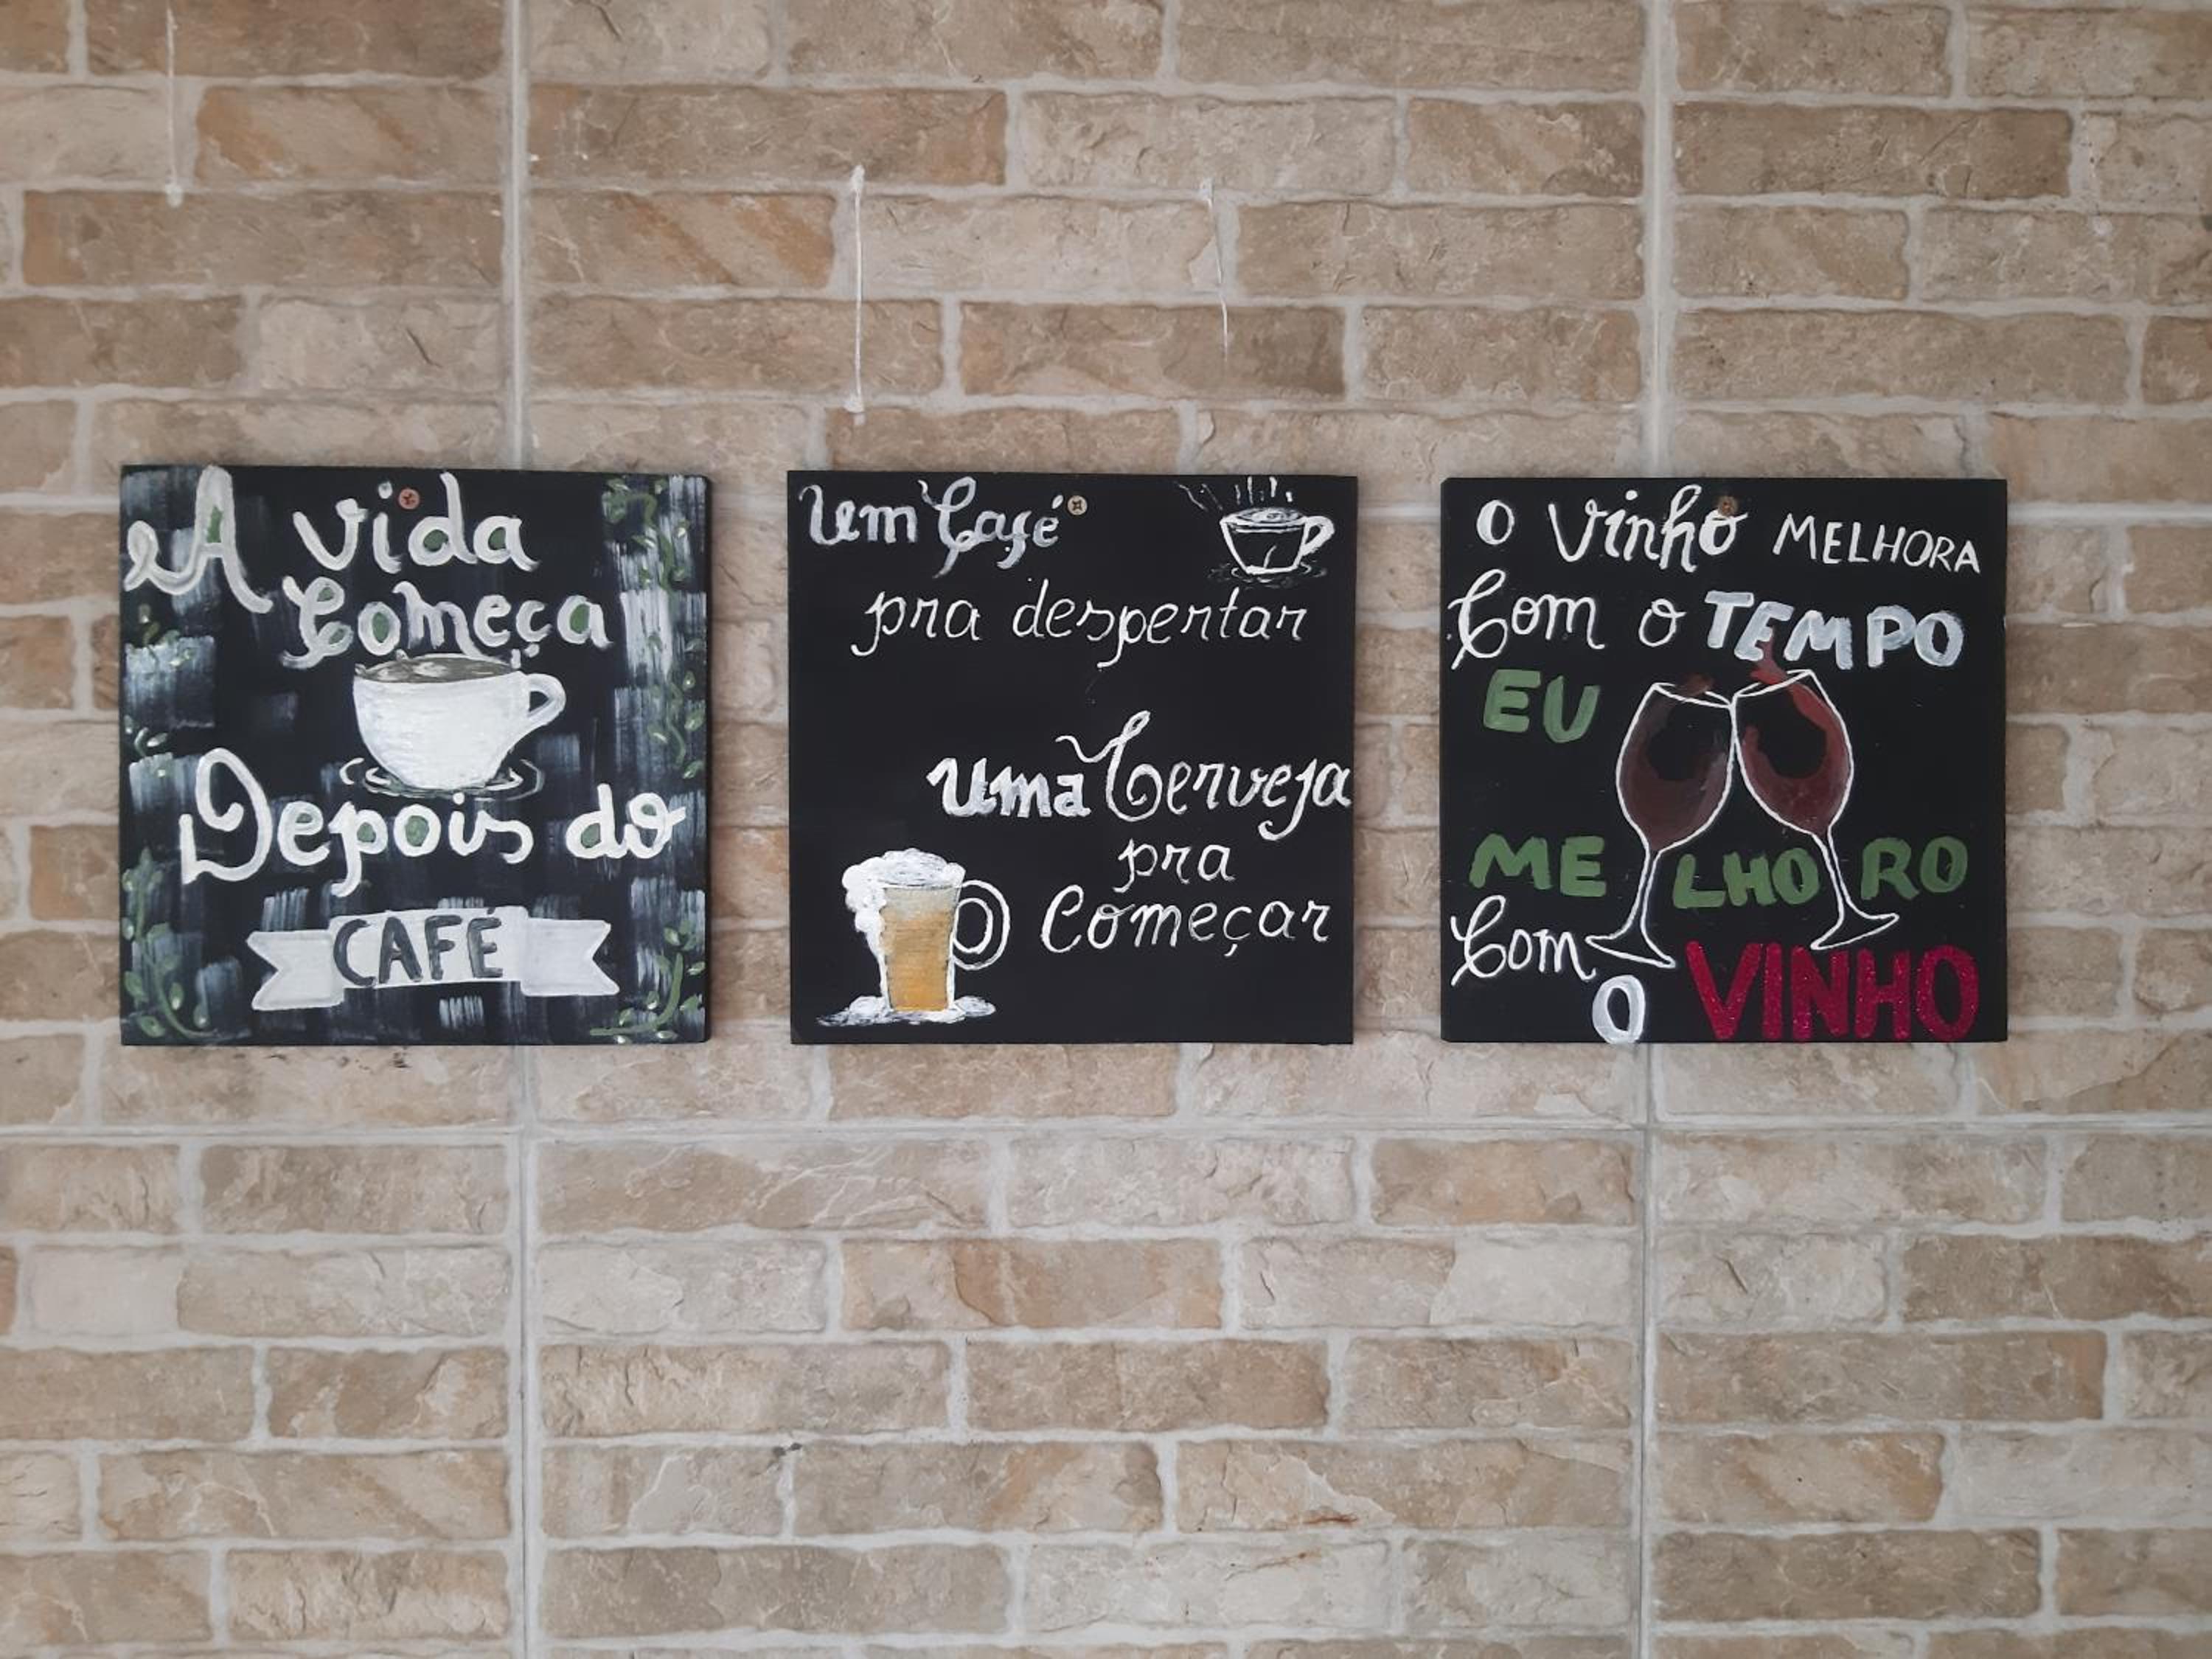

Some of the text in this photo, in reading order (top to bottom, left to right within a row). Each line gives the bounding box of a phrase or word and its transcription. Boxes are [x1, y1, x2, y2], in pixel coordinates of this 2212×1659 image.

[124, 465, 273, 613] A
[1773, 513, 1981, 574] MELHORA
[851, 579, 1307, 668] pra despertar
[1704, 590, 1965, 670] TEMPO
[1482, 669, 1600, 743] EU
[566, 783, 687, 860] do
[1113, 838, 1235, 893] pra
[1685, 940, 1980, 1043] VINHO
